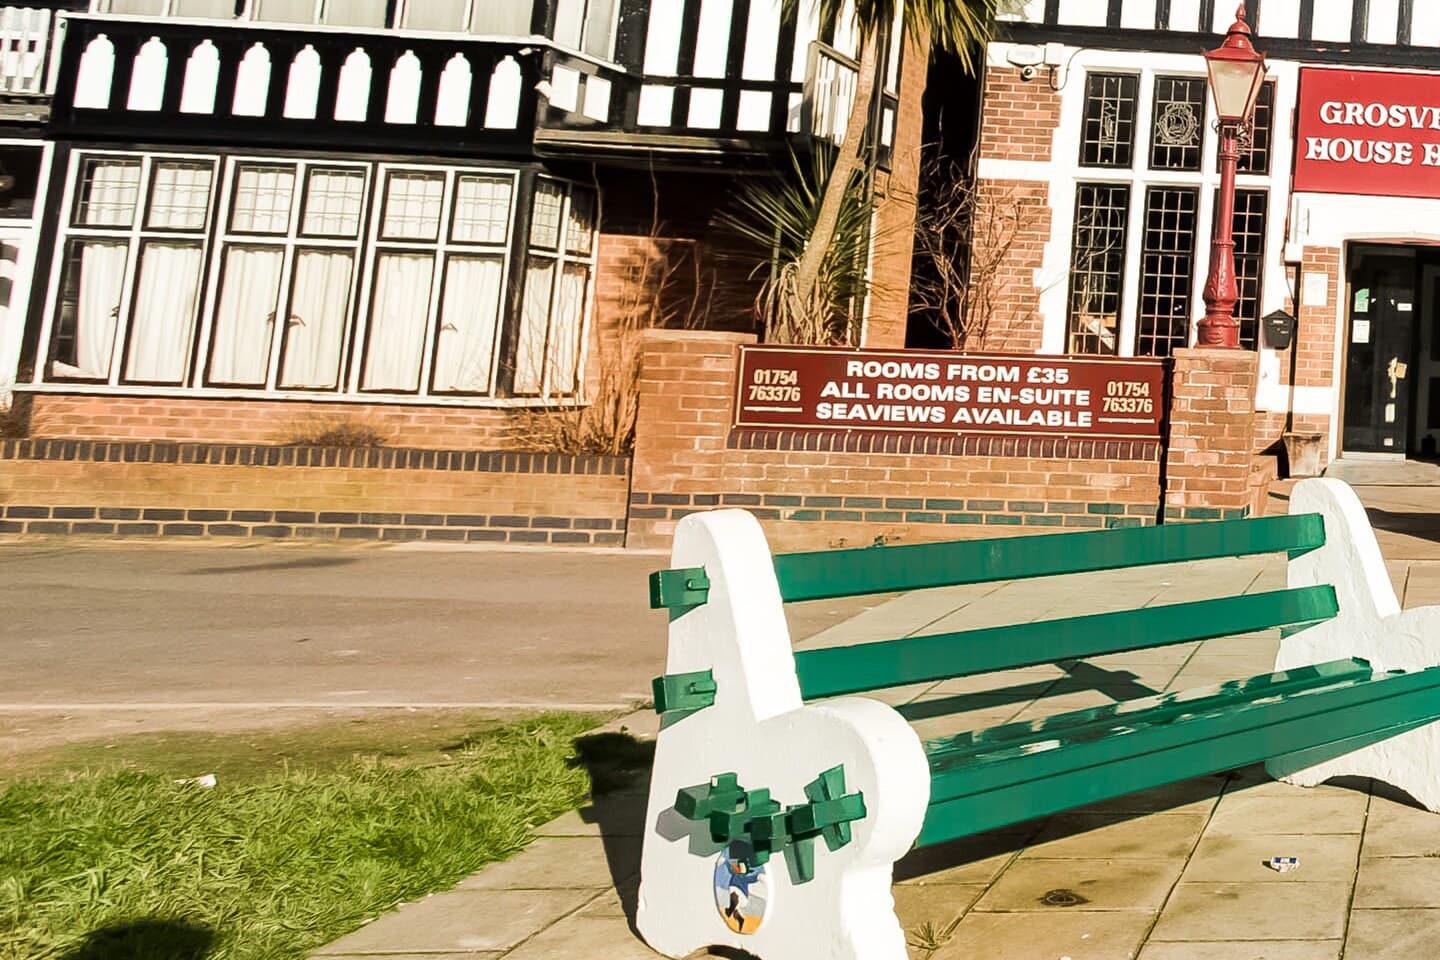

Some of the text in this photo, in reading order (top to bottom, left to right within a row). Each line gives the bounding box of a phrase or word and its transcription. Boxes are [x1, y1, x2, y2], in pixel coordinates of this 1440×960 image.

[1305, 137, 1413, 165] HOUSE
[754, 369, 798, 386] 01754
[847, 361, 1069, 384] ROOMS FROM £35
[749, 385, 800, 402] 763376
[820, 381, 1090, 406] ALL ROOMS EN-SUITE
[1107, 381, 1150, 397] 01754
[816, 403, 1093, 427] SEAVIEWS AVAILABLE
[1102, 397, 1153, 413] 763376
